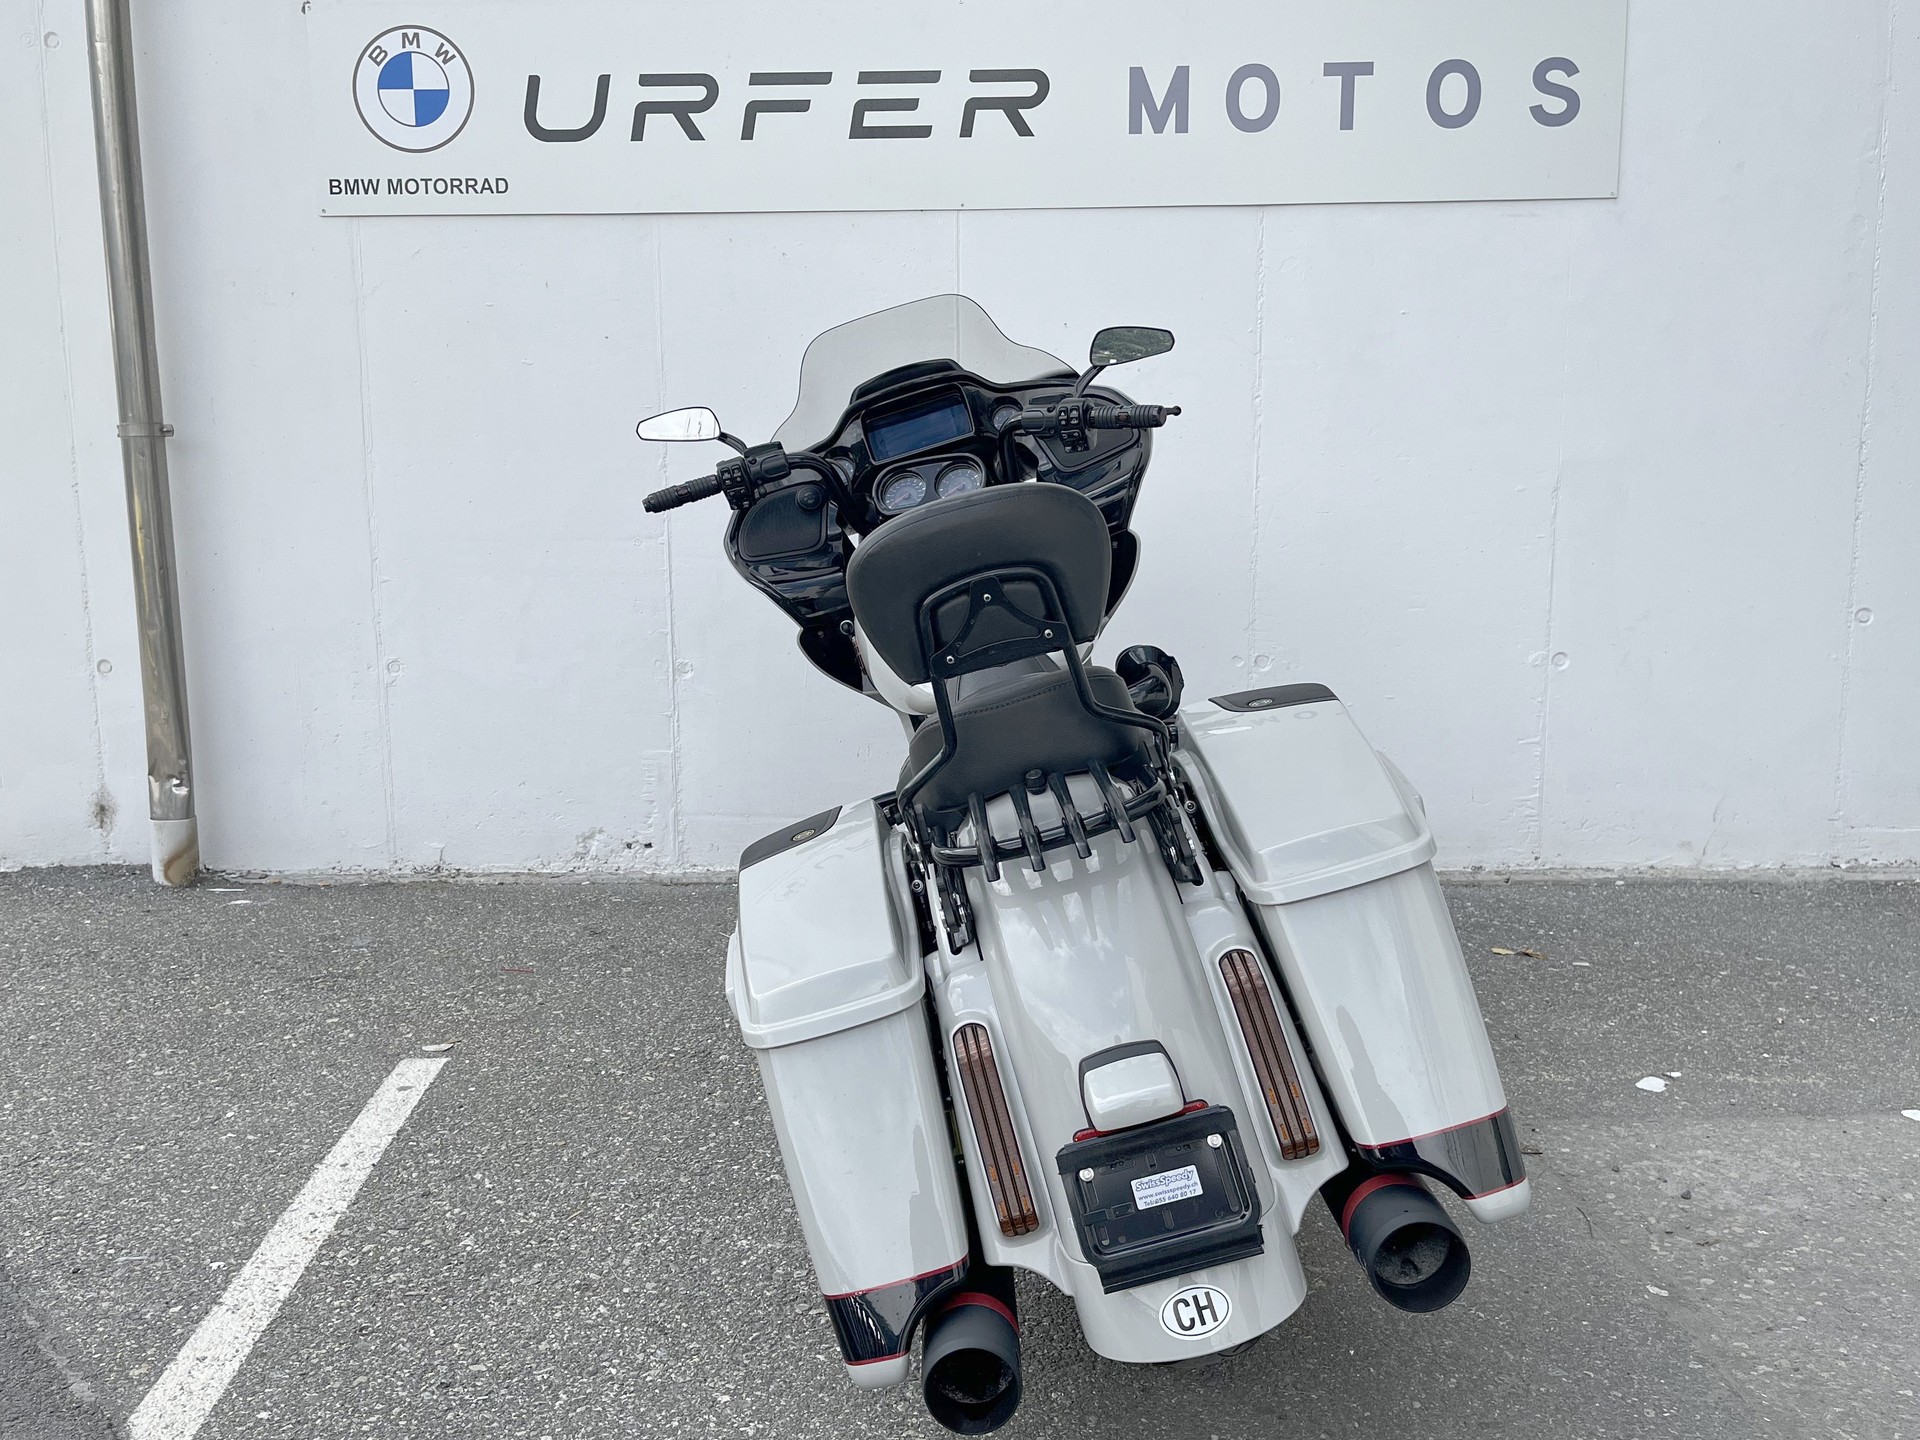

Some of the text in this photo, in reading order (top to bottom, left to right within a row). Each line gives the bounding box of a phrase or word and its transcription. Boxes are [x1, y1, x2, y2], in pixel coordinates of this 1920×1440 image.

[367, 32, 457, 67] BMW
[524, 57, 1581, 142] URFER MOTOS
[329, 177, 509, 195] BMW MOTORRAD
[1135, 1169, 1194, 1192] SwissSpeedy
[1172, 1291, 1219, 1331] CH
